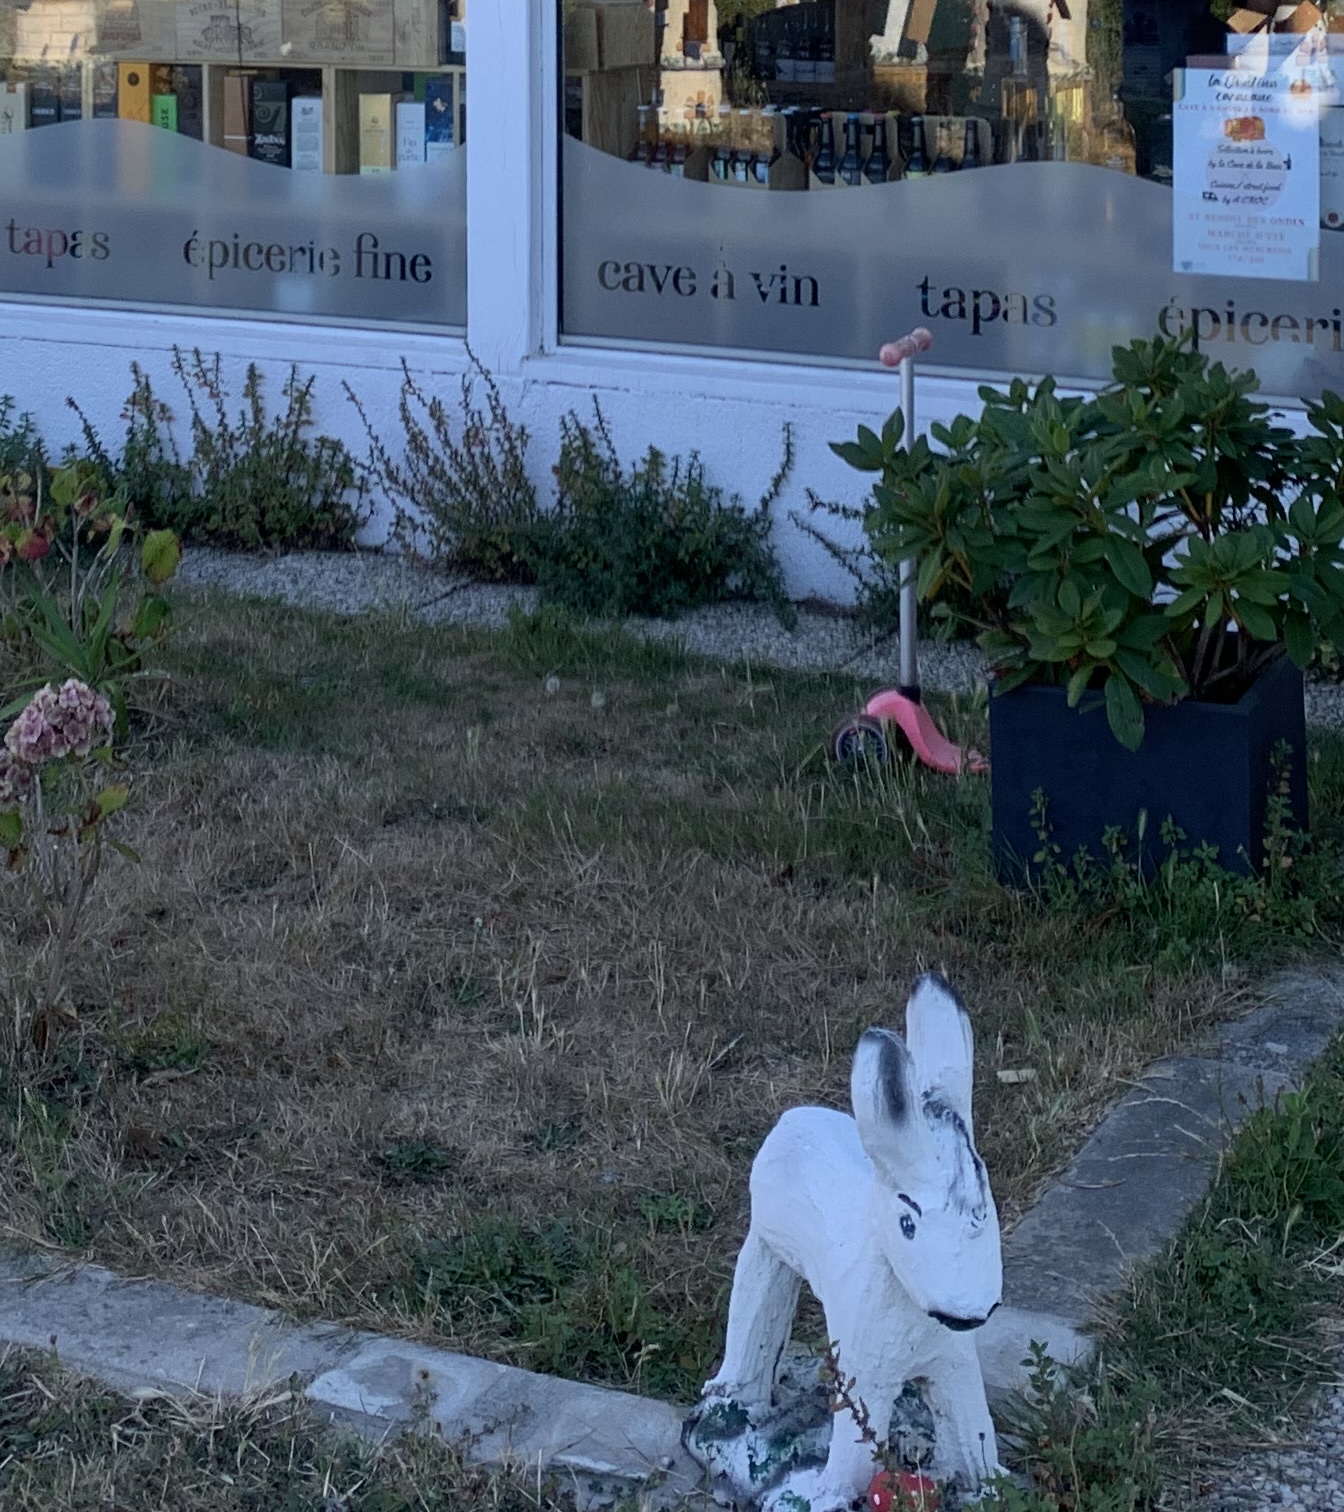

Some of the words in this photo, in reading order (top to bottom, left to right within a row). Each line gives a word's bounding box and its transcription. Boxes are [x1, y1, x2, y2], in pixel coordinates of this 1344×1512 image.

[6, 216, 111, 268] tapas
[182, 228, 343, 281] épicerie
[351, 232, 435, 285] fine
[598, 259, 696, 297] cave
[710, 261, 737, 300] à
[750, 265, 820, 307] vin
[916, 274, 1058, 336] tapas
